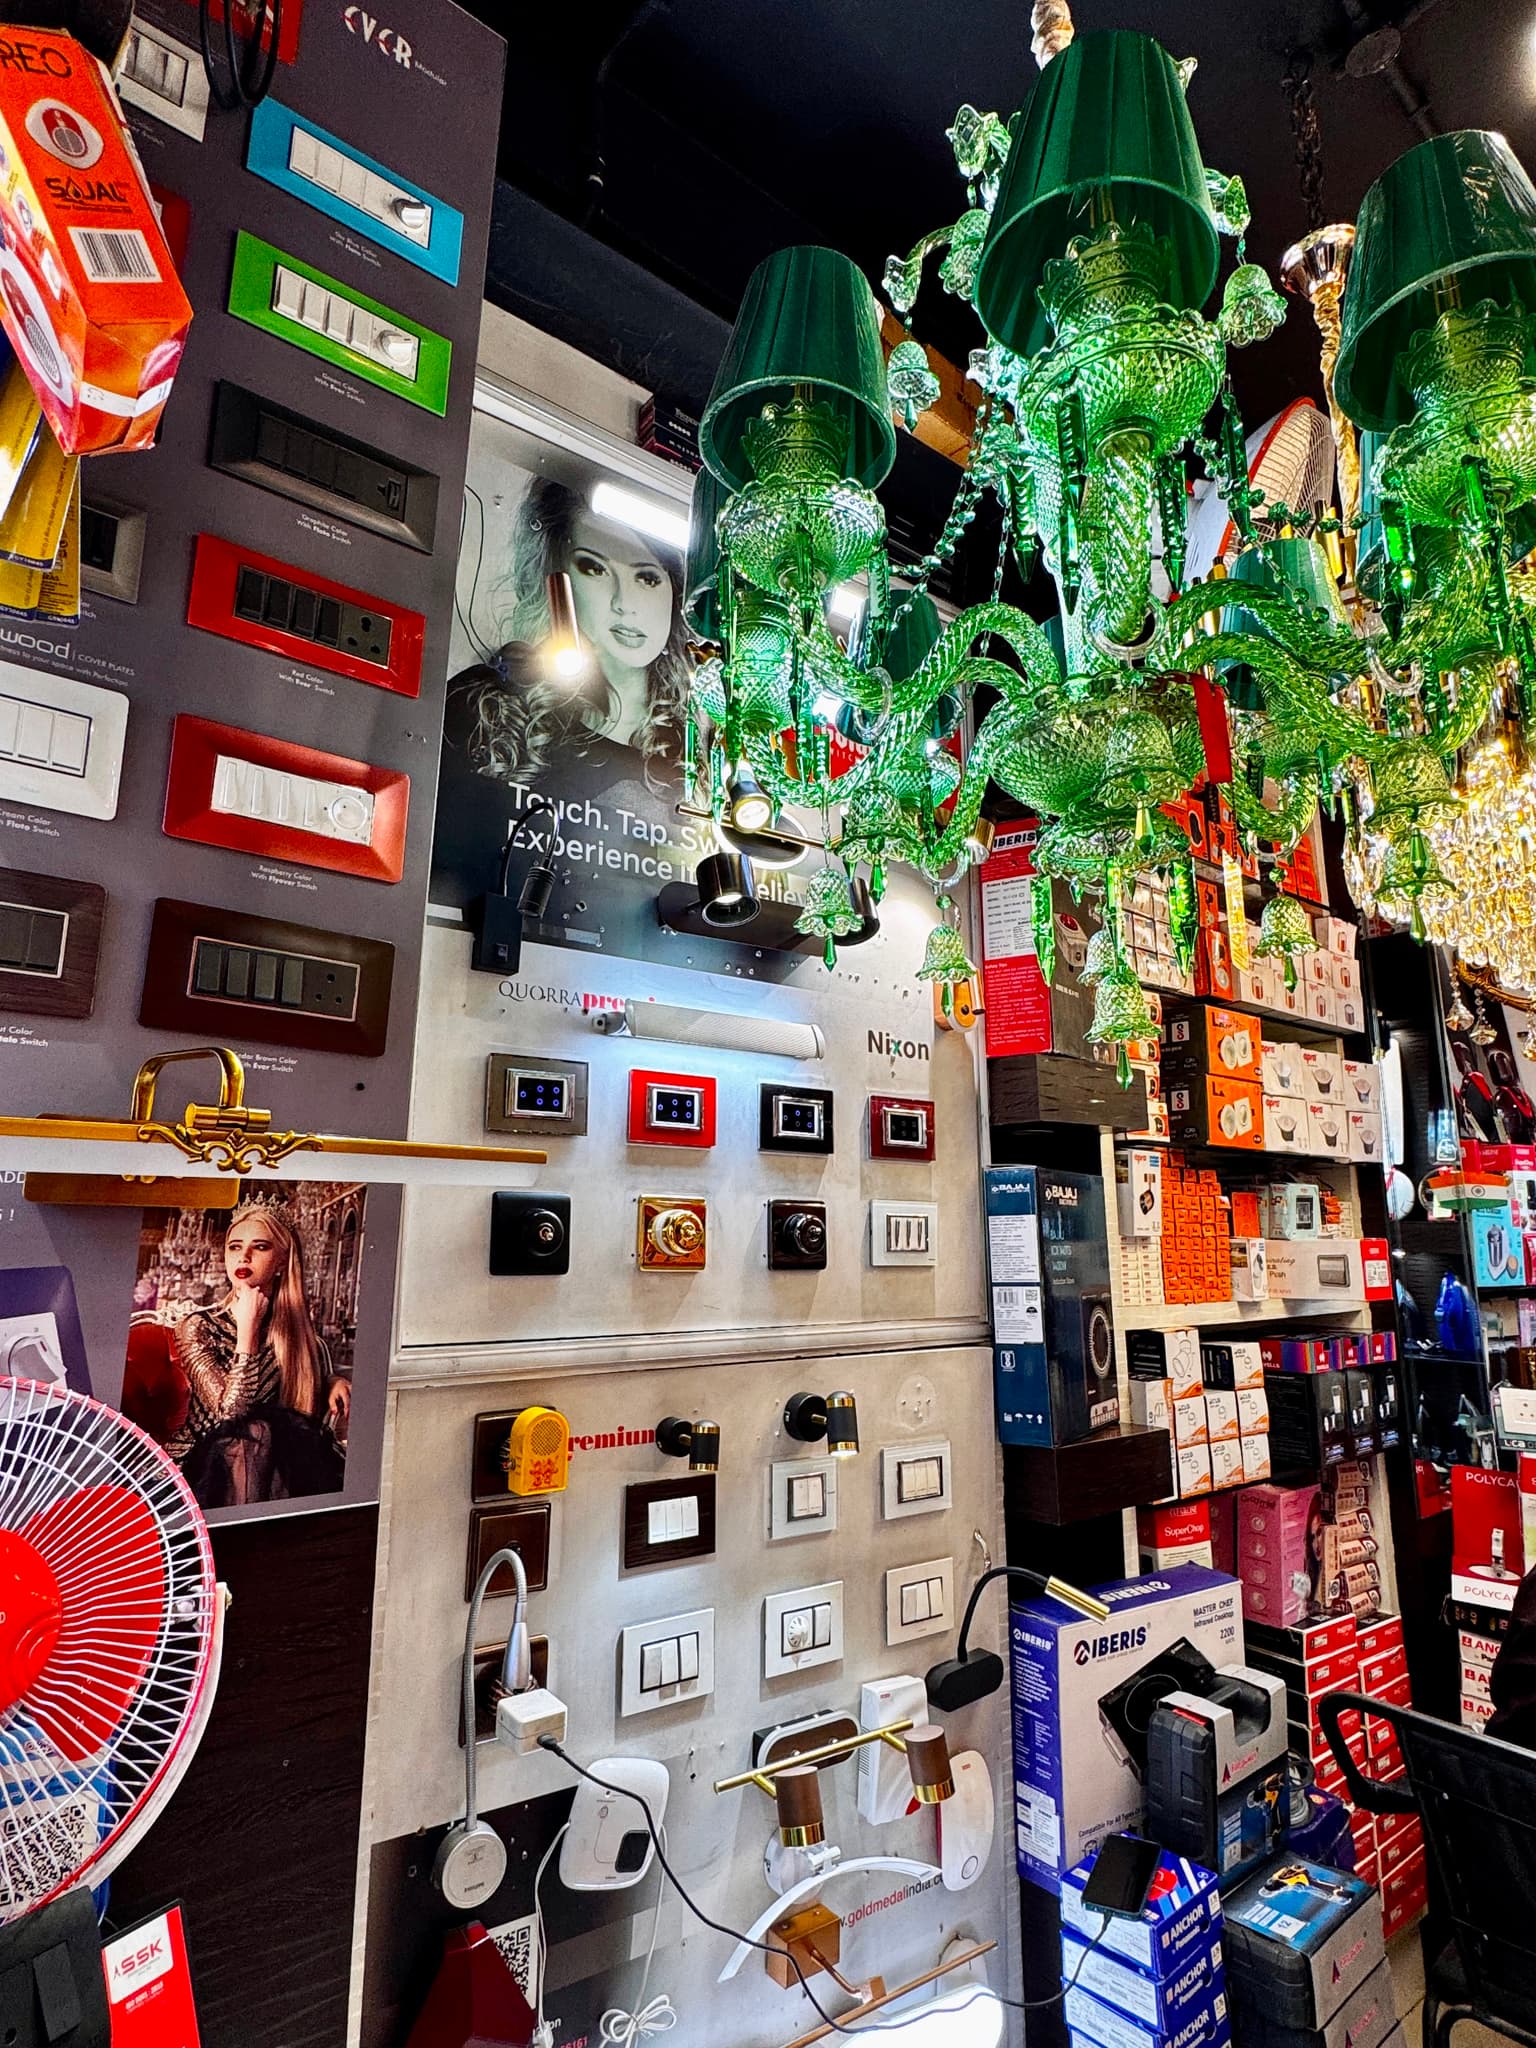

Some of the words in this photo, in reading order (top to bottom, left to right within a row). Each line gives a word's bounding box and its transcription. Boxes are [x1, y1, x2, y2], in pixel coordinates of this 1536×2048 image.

[295, 518, 312, 530] With
[331, 533, 352, 546] Switch
[78, 653, 107, 669] COVER
[108, 662, 136, 677] PLATES
[279, 671, 295, 685] With
[315, 684, 336, 697] Switch
[306, 673, 324, 684] Color
[27, 814, 52, 826] Color
[508, 782, 610, 832] Touch.
[616, 807, 674, 848] Tap.
[32, 825, 60, 838] Switch
[993, 831, 1037, 850] IBERIS
[506, 819, 674, 882] Experience
[251, 871, 268, 881] With
[268, 875, 297, 887] Flyover
[297, 881, 318, 891] Switch
[259, 864, 293, 879] Raspberry
[293, 872, 313, 882] Color
[9, 1026, 35, 1036] Color
[19, 1037, 49, 1049] Switch
[867, 1029, 930, 1061] Nixon
[254, 1053, 278, 1063] Brown
[278, 1056, 298, 1065] Color
[271, 1064, 294, 1073] Switch
[999, 1183, 1031, 1191] BAJAJ
[1052, 1185, 1079, 1200] BAJAJ
[567, 1425, 656, 1453] remium
[1465, 1471, 1517, 1489] POLYCA
[1164, 1523, 1205, 1539] SuperChop
[1464, 1585, 1515, 1602] POLYCA
[1192, 1603, 1217, 1617] MASTER
[1218, 1598, 1234, 1609] CHEF
[1194, 1618, 1214, 1629] Infrared
[1214, 1611, 1235, 1623] Cooktop
[1021, 1631, 1052, 1651] IBERIS
[1092, 1625, 1147, 1659] IBERIS
[1079, 1823, 1106, 1838] Compatible
[1170, 1903, 1205, 1940] ANCHOR
[1173, 1956, 1208, 1997] ANCHOR
[1173, 2008, 1210, 2048] ANCHOR
